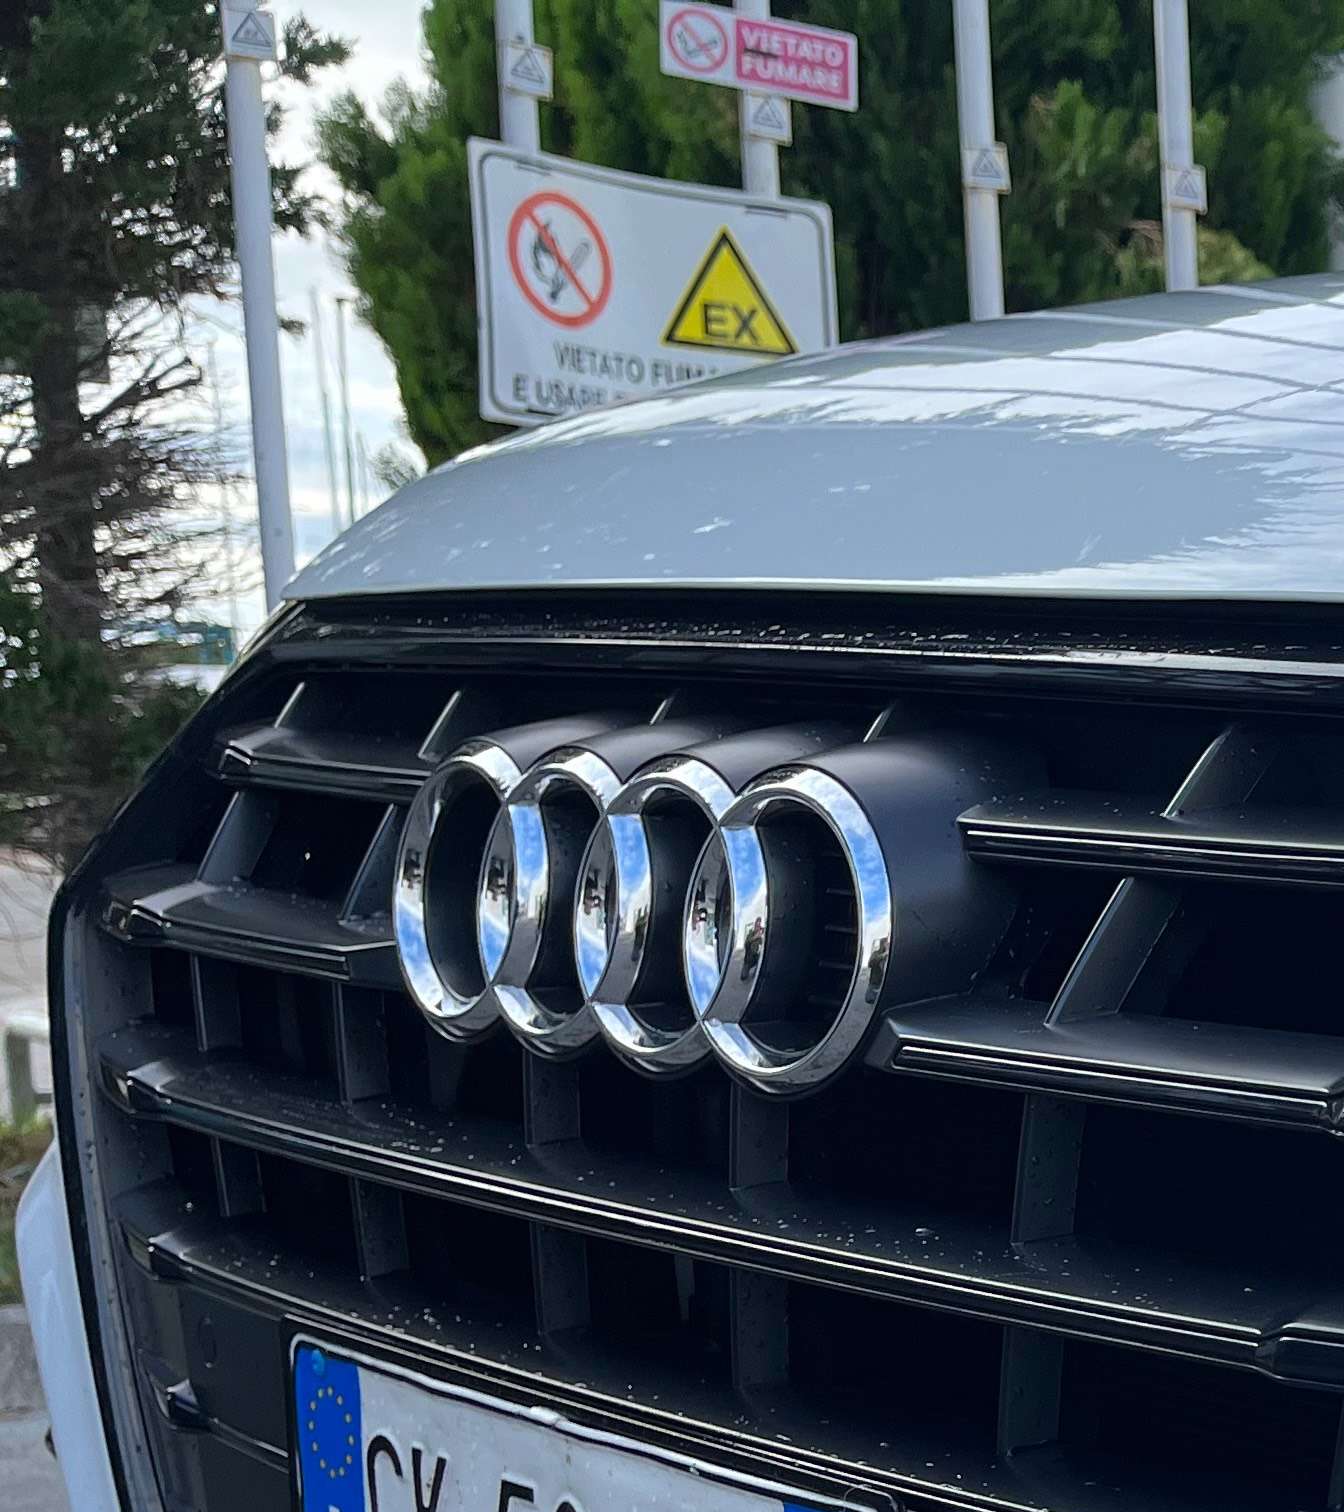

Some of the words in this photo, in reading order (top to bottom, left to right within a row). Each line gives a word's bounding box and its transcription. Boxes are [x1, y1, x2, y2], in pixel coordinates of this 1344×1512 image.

[741, 27, 844, 67] VIETATO
[741, 54, 844, 93] FUMARE
[703, 303, 758, 344] EX
[553, 341, 646, 384] VIETATO
[512, 372, 528, 403] E
